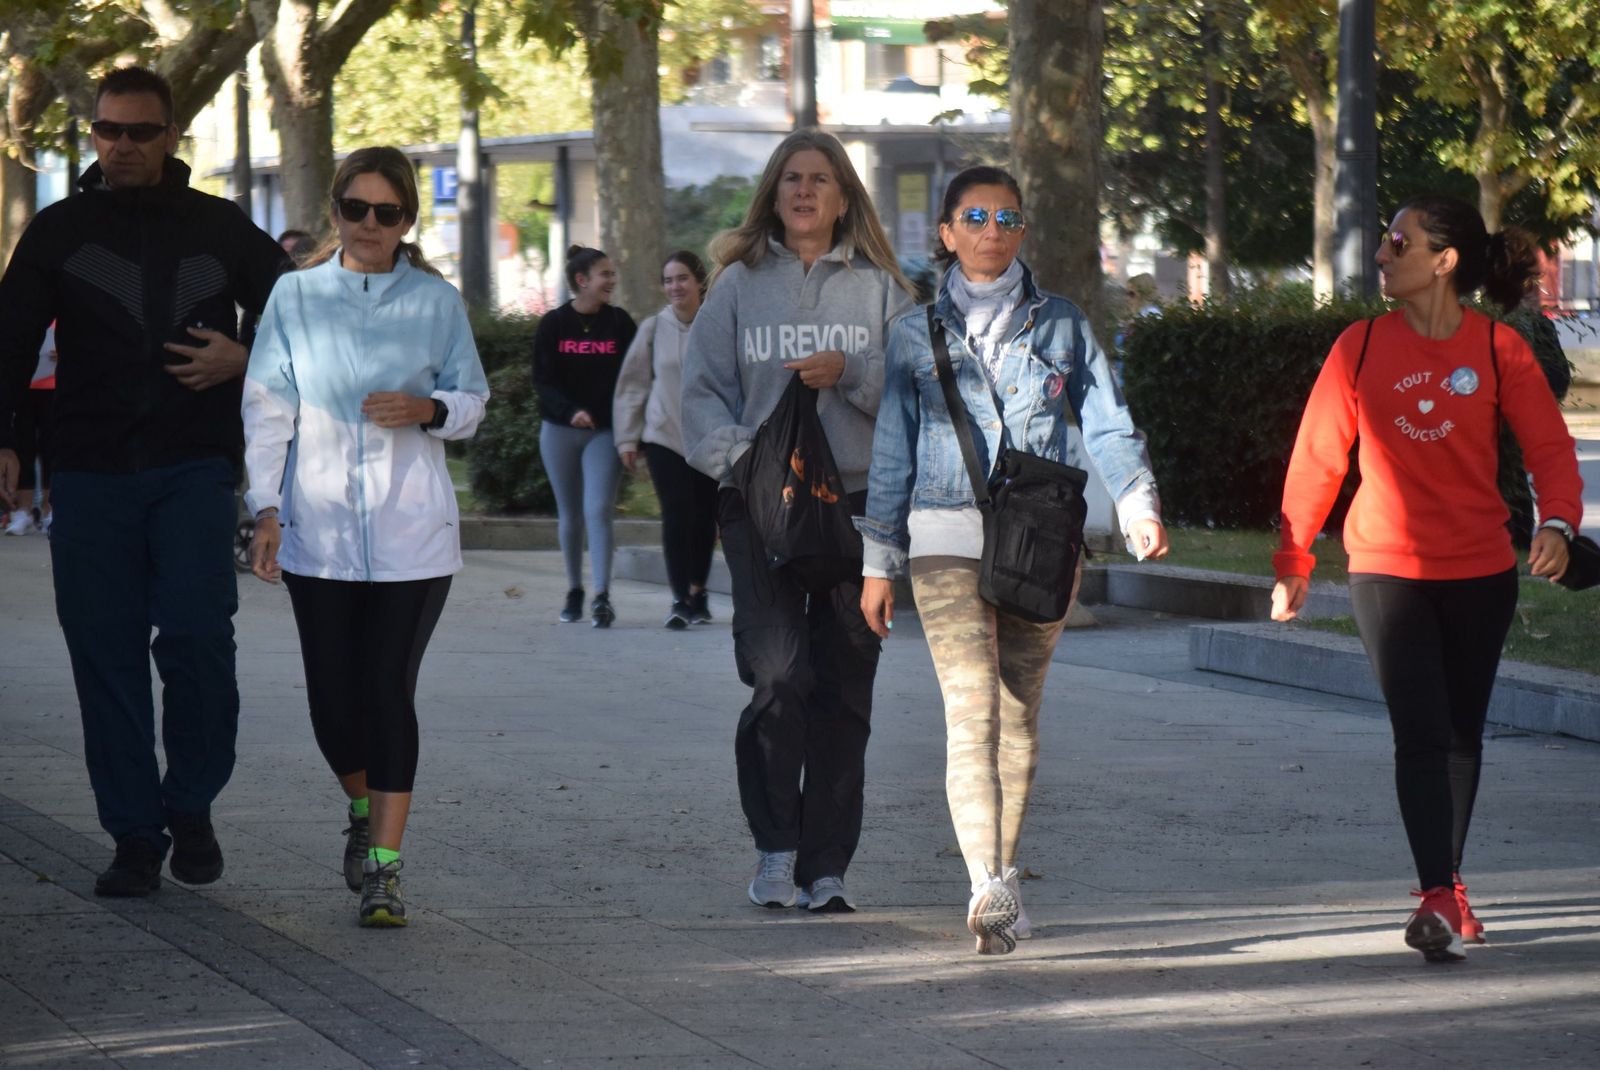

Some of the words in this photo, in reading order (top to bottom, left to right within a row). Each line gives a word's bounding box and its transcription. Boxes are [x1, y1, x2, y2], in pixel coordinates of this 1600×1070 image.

[559, 340, 616, 353] IRENE
[744, 325, 771, 364] AU
[779, 323, 870, 359] REVOIR
[1393, 371, 1432, 393] TOUT
[1440, 377, 1457, 396] E
[1394, 415, 1456, 442] DOUCEUR
